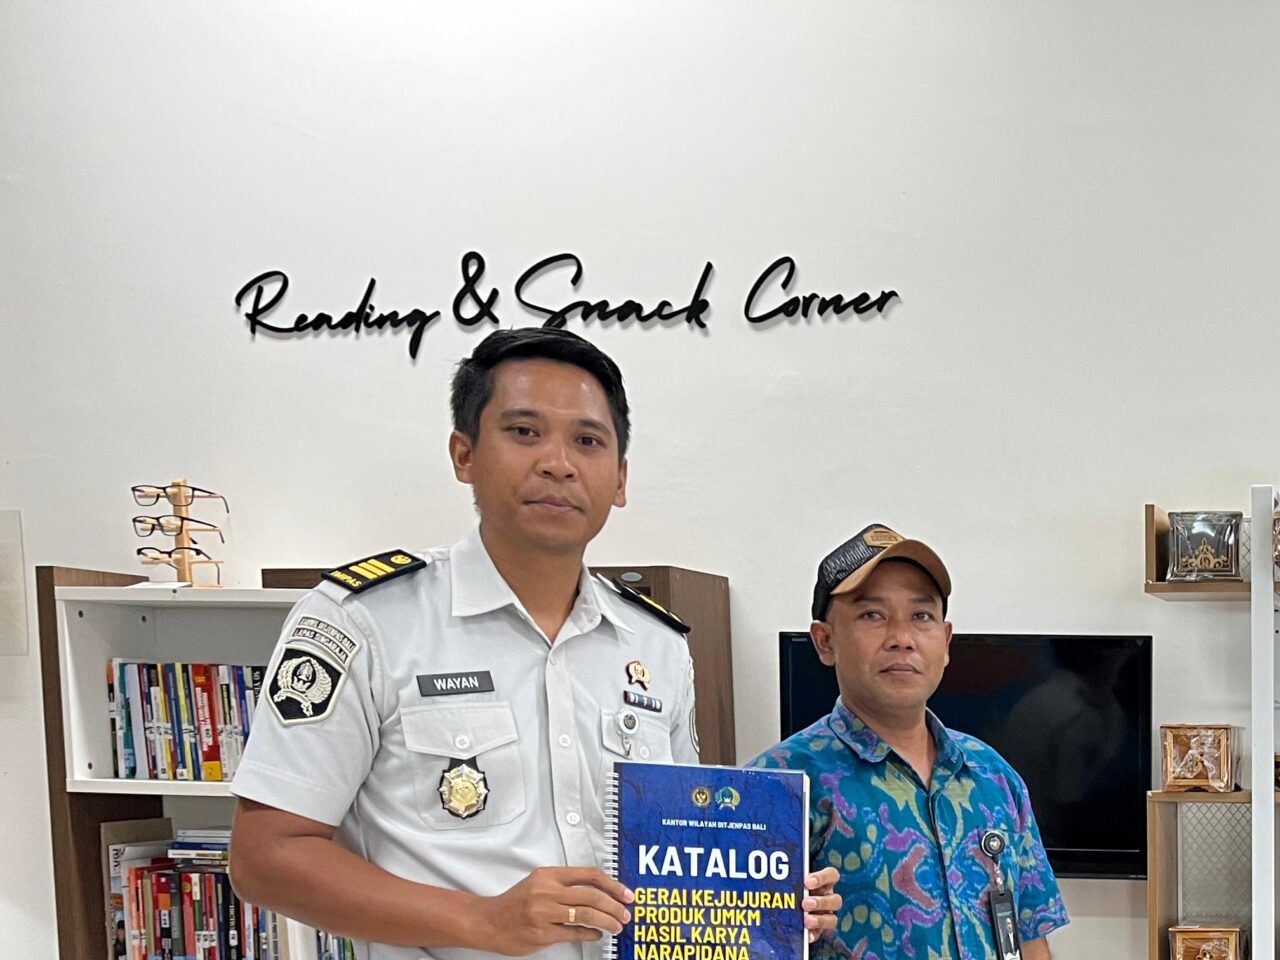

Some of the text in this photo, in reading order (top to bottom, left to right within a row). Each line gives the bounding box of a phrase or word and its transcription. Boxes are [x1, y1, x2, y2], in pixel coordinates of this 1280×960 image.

[235, 250, 900, 364] Reading & Snack Corner
[434, 676, 479, 690] WAYAN
[662, 818, 687, 826] KANTOR
[688, 820, 716, 828] WILAYAH
[717, 821, 752, 830] DITJENPAS
[638, 845, 789, 880] KATALOG
[634, 888, 795, 909] GERAI KEJUJURAN
[634, 907, 760, 926] PRODUK UMKM
[634, 926, 750, 944] HASIL KARYA
